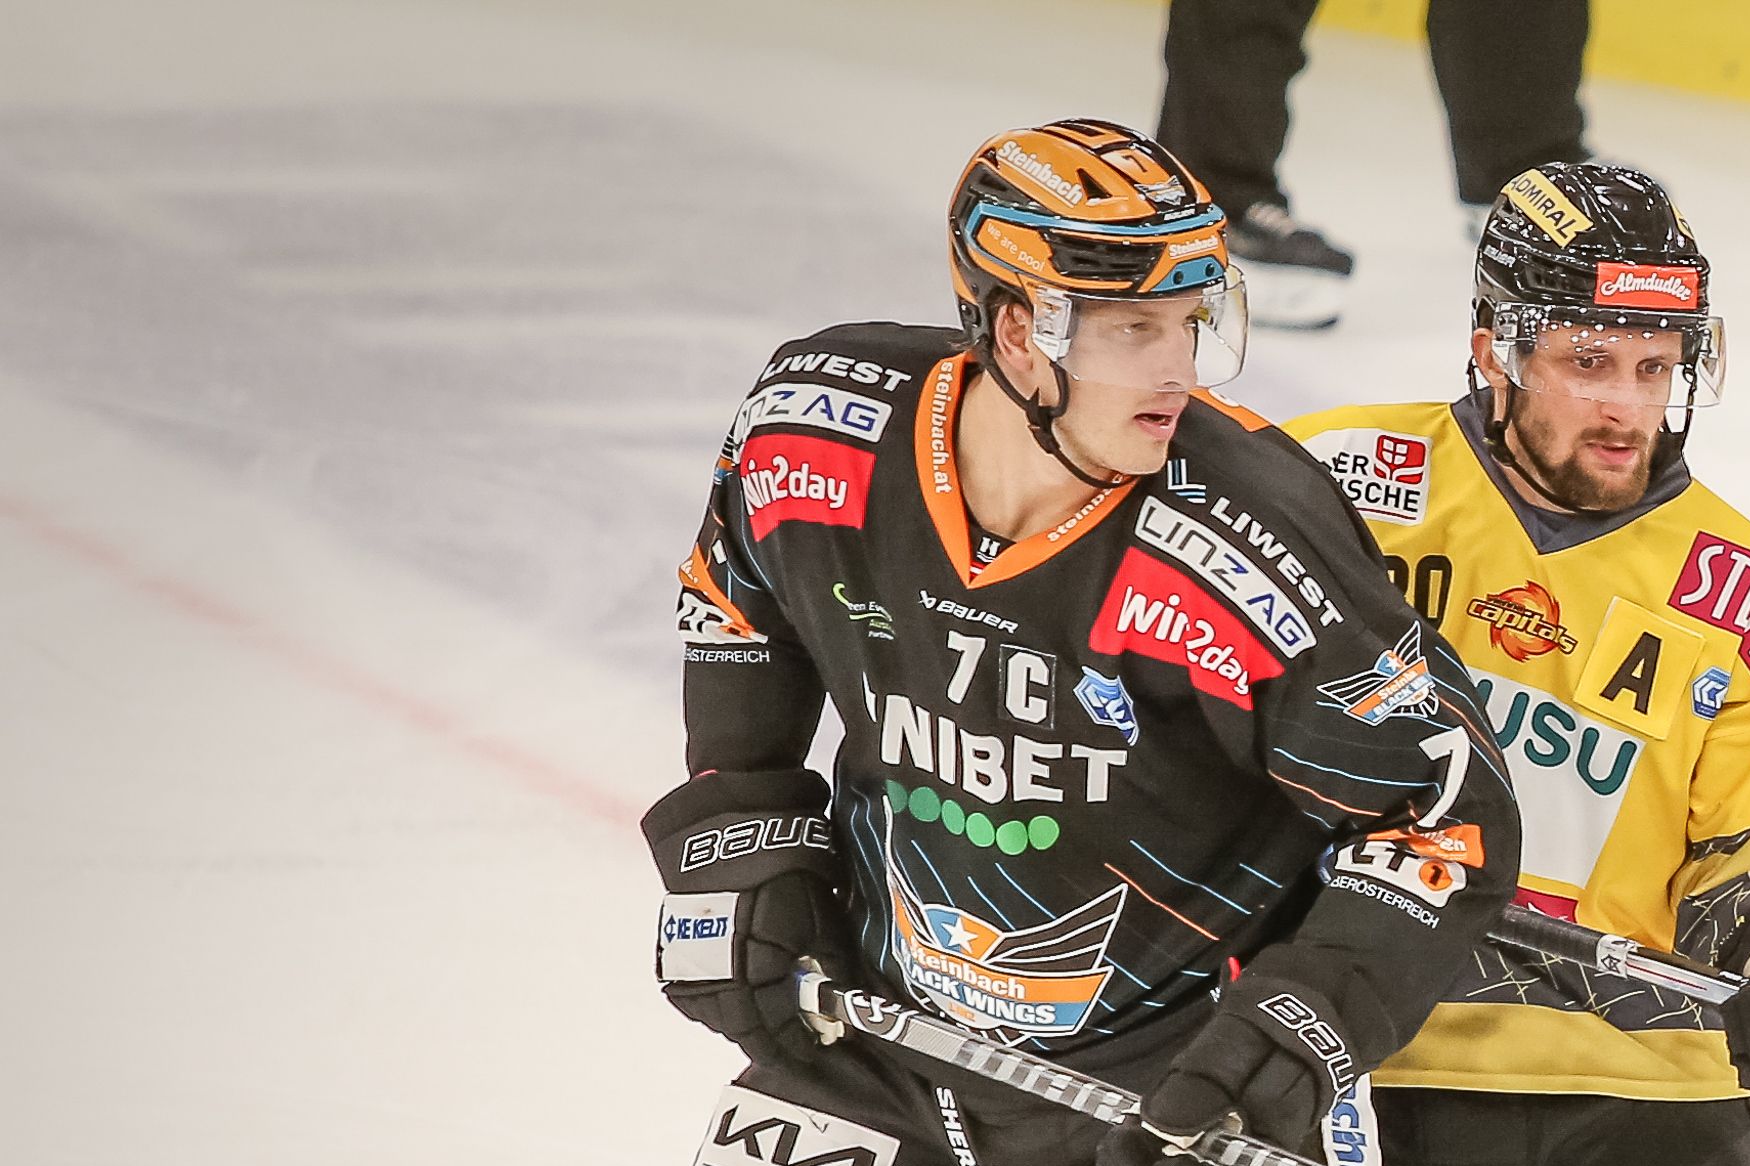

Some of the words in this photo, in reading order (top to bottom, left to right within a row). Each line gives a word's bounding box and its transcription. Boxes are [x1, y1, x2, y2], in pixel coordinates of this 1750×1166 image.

[997, 140, 1085, 205] Steinbach
[1512, 173, 1569, 241] ADMIRAL
[1017, 250, 1045, 273] pool
[1600, 271, 1692, 301] Almdudler
[800, 393, 880, 433] AG
[930, 361, 954, 494] steinbach.at
[1209, 495, 1345, 628] LIWEST
[1245, 592, 1307, 647] AG
[946, 629, 987, 705] 7
[1004, 650, 1050, 726] C
[1599, 630, 1663, 716] A
[863, 690, 1129, 805] NIBET
[1476, 678, 1639, 796] USU
[1418, 725, 1472, 829] 7
[679, 816, 833, 873] BAUE
[963, 984, 1057, 1025] WINGS
[1256, 992, 1354, 1093] BAU
